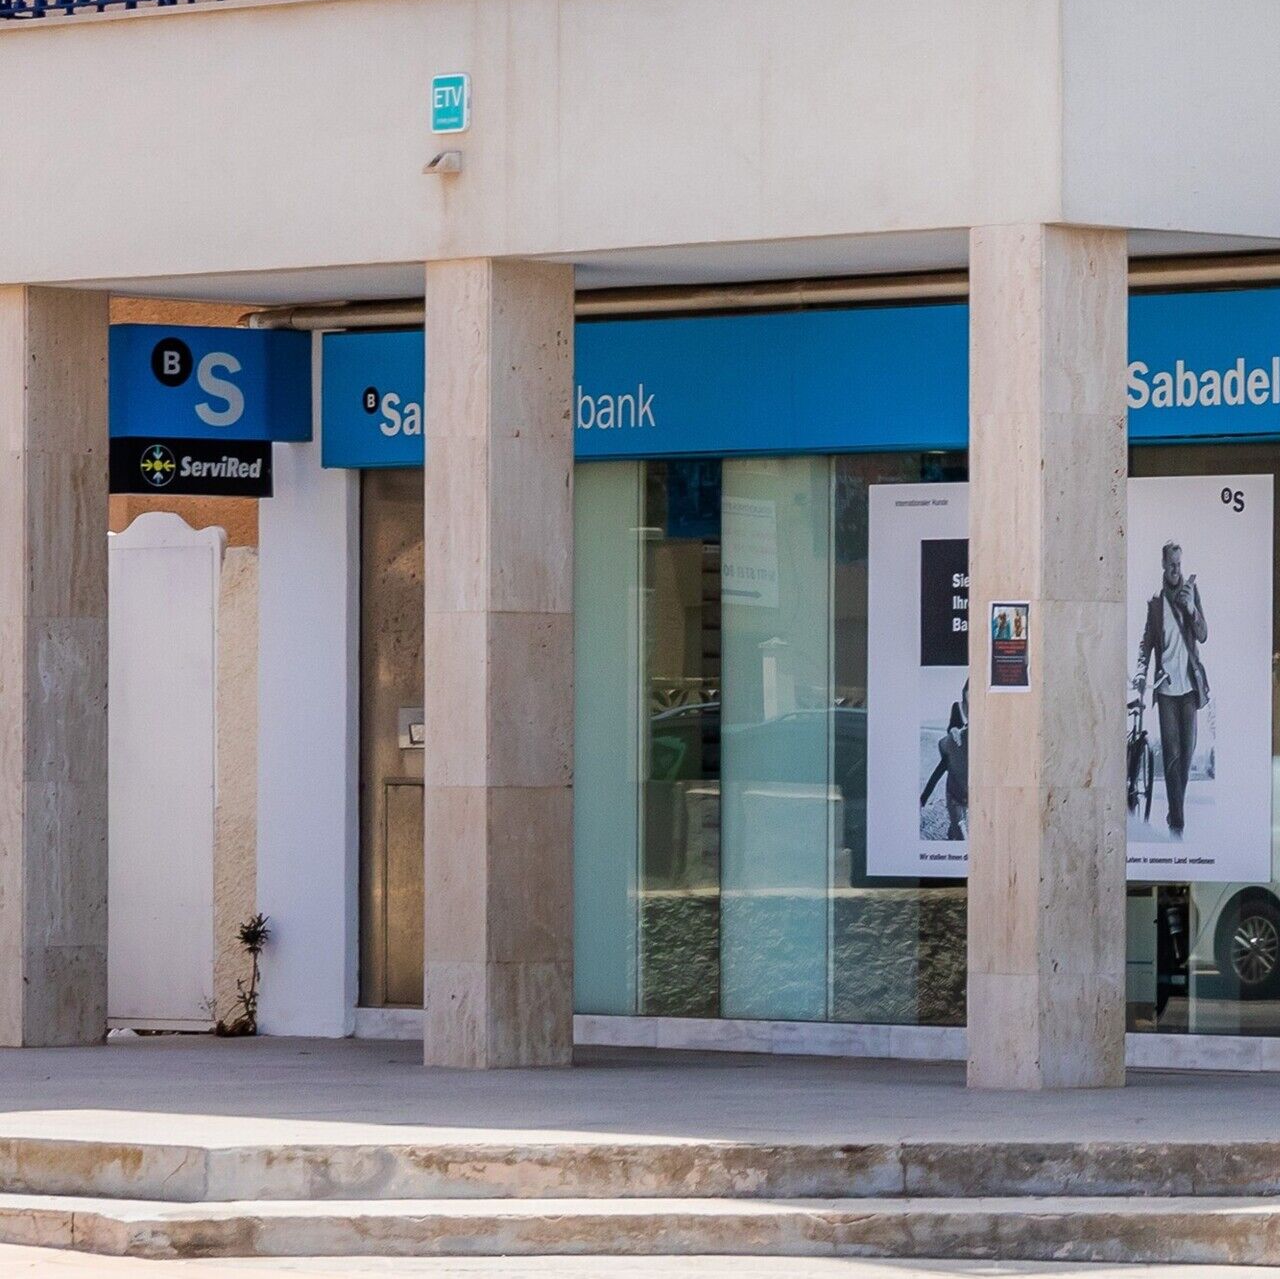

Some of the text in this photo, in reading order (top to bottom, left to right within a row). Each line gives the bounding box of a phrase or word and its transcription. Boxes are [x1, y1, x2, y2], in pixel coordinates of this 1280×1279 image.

[434, 85, 463, 108] ETV
[194, 351, 245, 427] S
[380, 392, 425, 437] Sa
[577, 383, 656, 430] bank
[180, 455, 262, 478] ServiRed
[952, 573, 969, 588] Sie
[952, 595, 968, 609] Ihr
[952, 617, 968, 632] Ba
